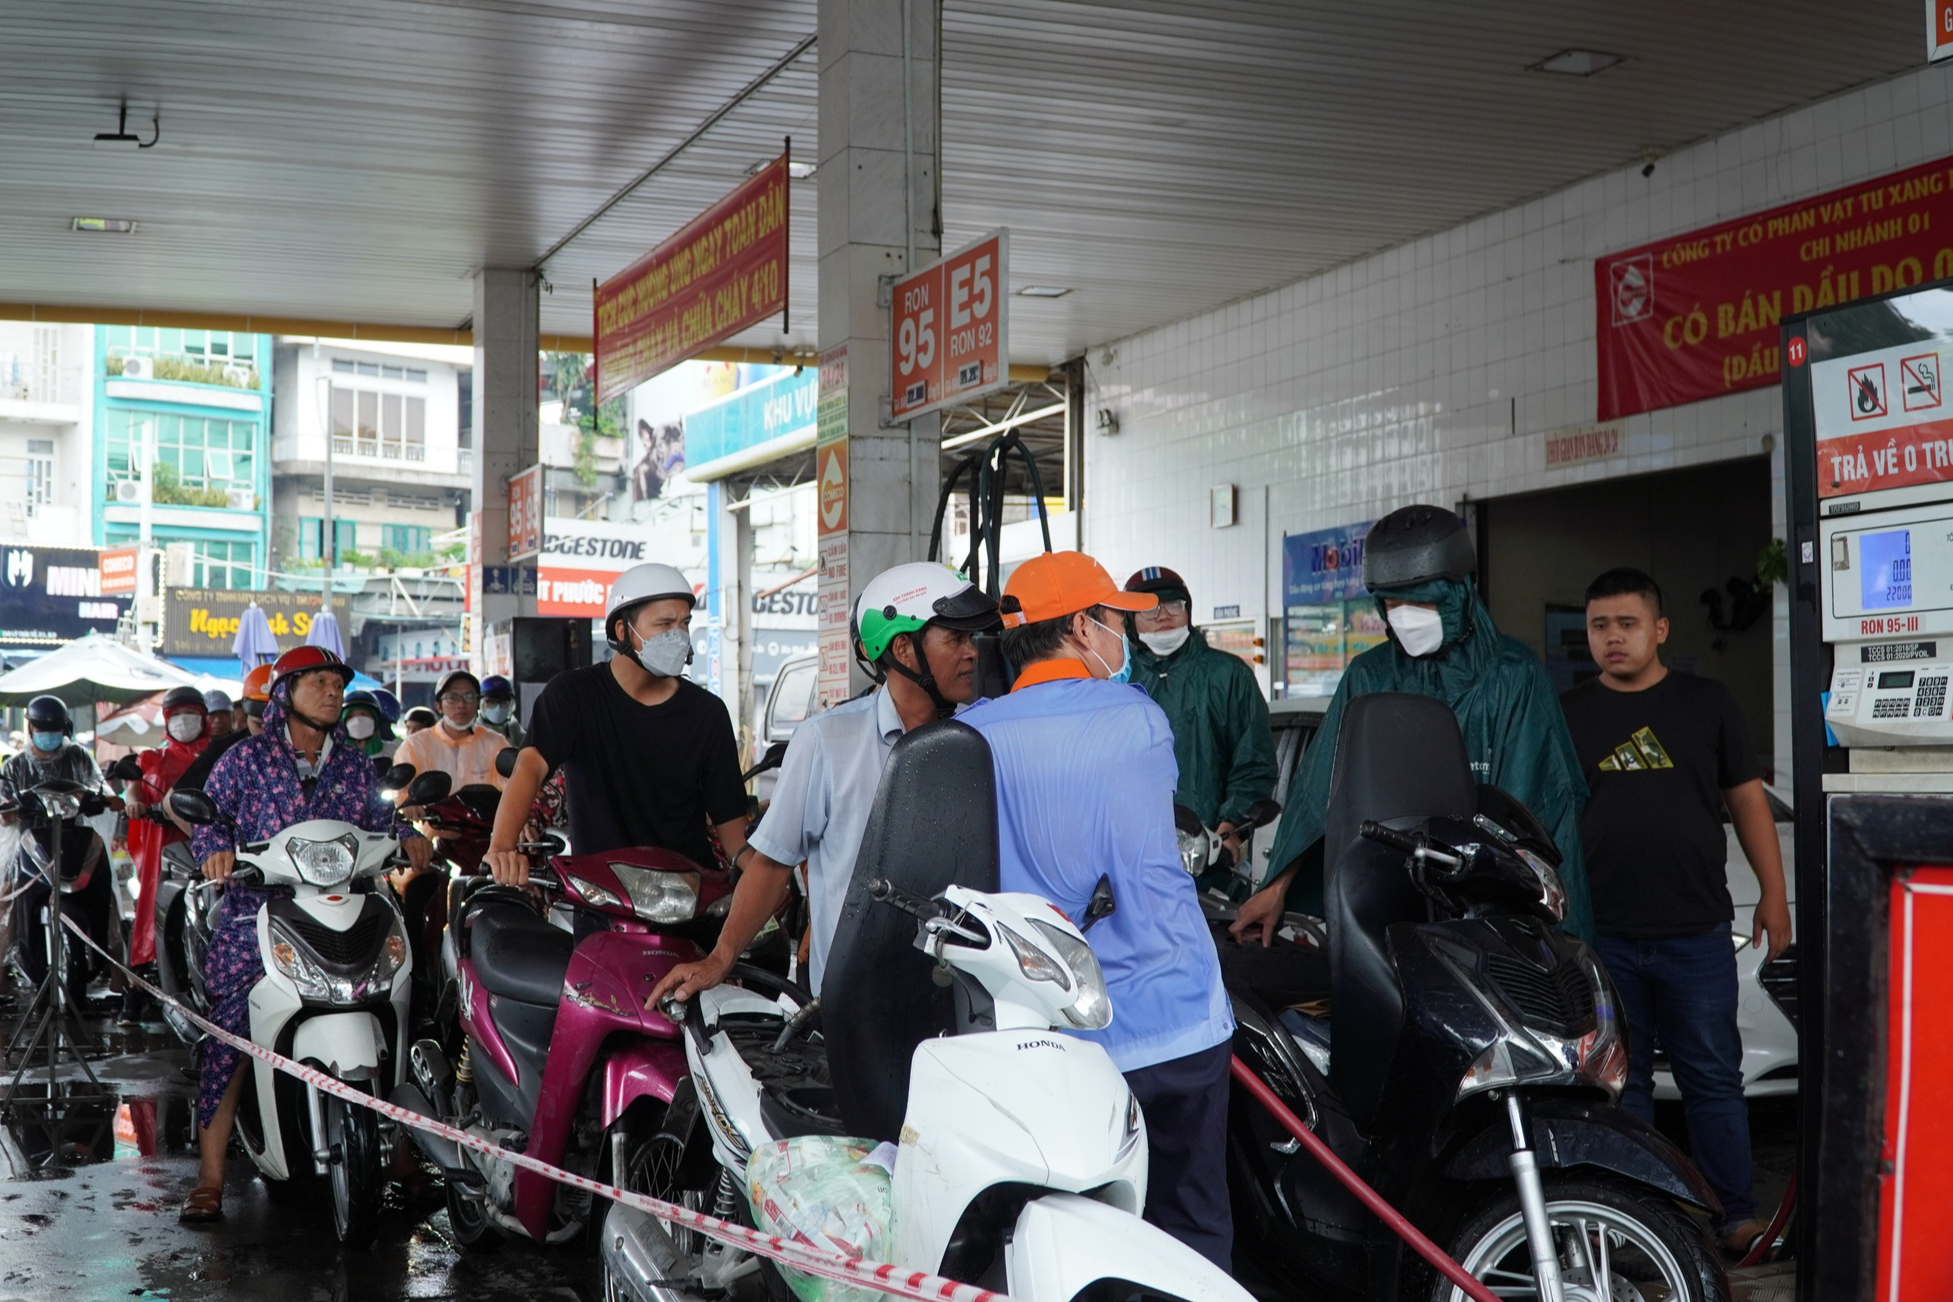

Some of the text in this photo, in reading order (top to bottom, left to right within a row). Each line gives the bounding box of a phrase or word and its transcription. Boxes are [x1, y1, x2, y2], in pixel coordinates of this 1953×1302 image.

[758, 180, 784, 238] DÂN
[1662, 237, 1709, 269] CÔNG
[1714, 231, 1734, 254] TY
[1800, 210, 1930, 262] CHI NHÁNH 01
[715, 269, 748, 331] CHÁY
[899, 307, 935, 376] 95
[951, 253, 992, 330] E5
[905, 283, 929, 314] RON
[1663, 303, 1708, 350] CÓ
[1718, 290, 1782, 339] BÁN
[951, 321, 992, 358] RON 92
[1790, 343, 1802, 360] 11
[764, 392, 792, 430] KHU
[795, 379, 818, 420] VỰ
[1831, 445, 1869, 482] TRẢ
[1873, 438, 1898, 476] VỀ
[510, 499, 522, 537] 95
[1830, 503, 1859, 513] TATSUNO
[1311, 539, 1365, 575] Mobil
[78, 602, 118, 619] HAIR
[1861, 616, 1918, 634] RON 95-III
[1868, 647, 1885, 655] TCCS
[1868, 653, 1885, 661] TCCS
[643, 950, 679, 958] HONDA
[1017, 1039, 1066, 1052] HONDA
